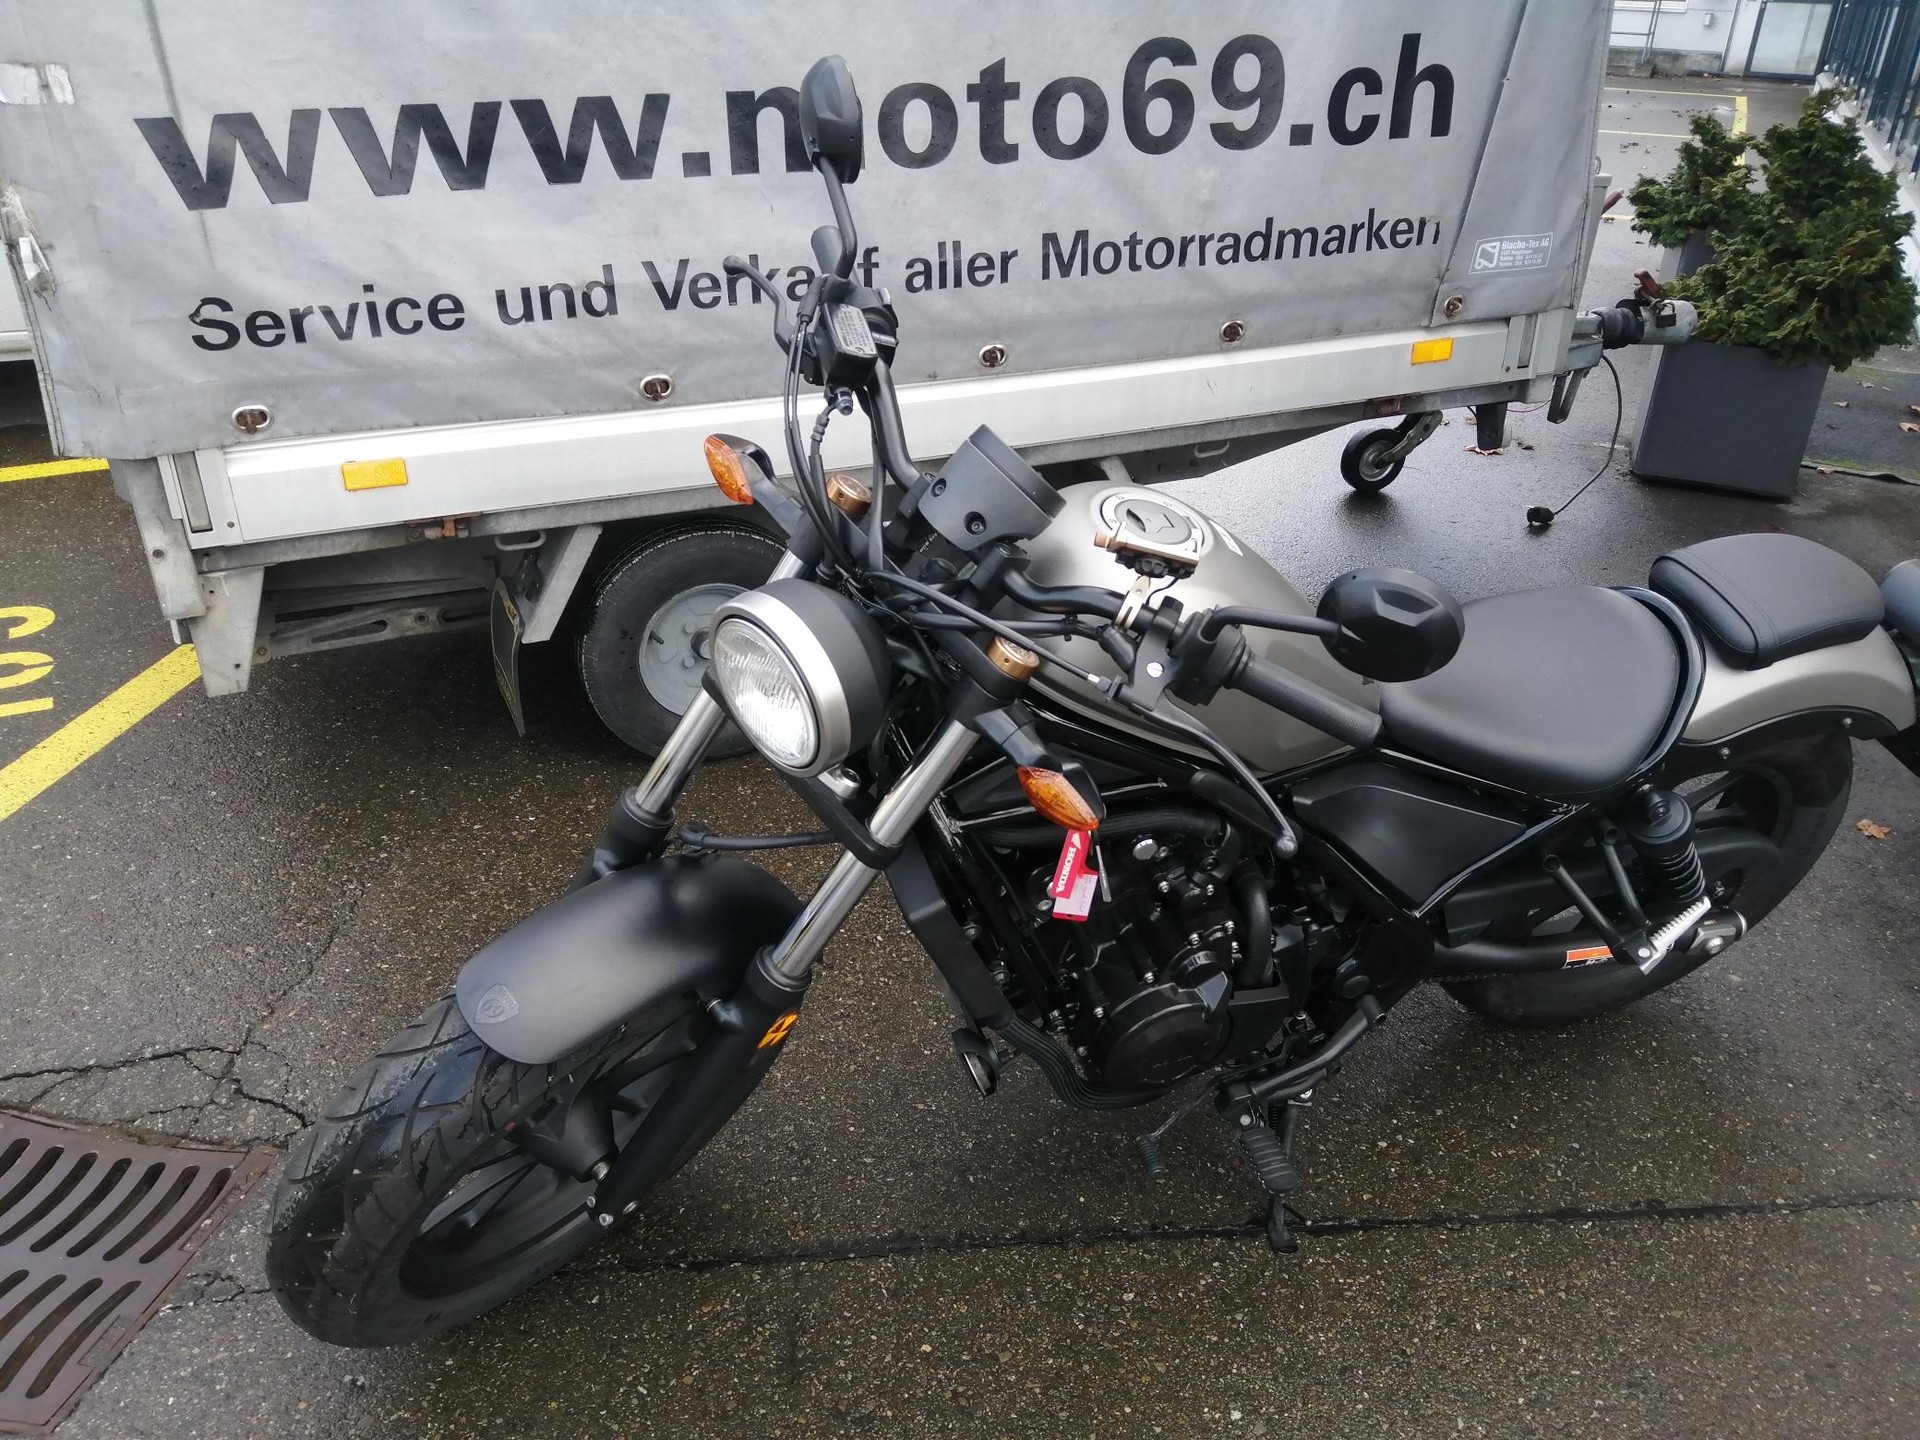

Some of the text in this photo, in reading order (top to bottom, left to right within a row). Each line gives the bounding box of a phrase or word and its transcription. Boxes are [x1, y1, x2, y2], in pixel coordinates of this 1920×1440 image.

[189, 208, 1441, 351] Service und Verkaf aller Motorradmarken
[1056, 846, 1077, 893] HONDA
